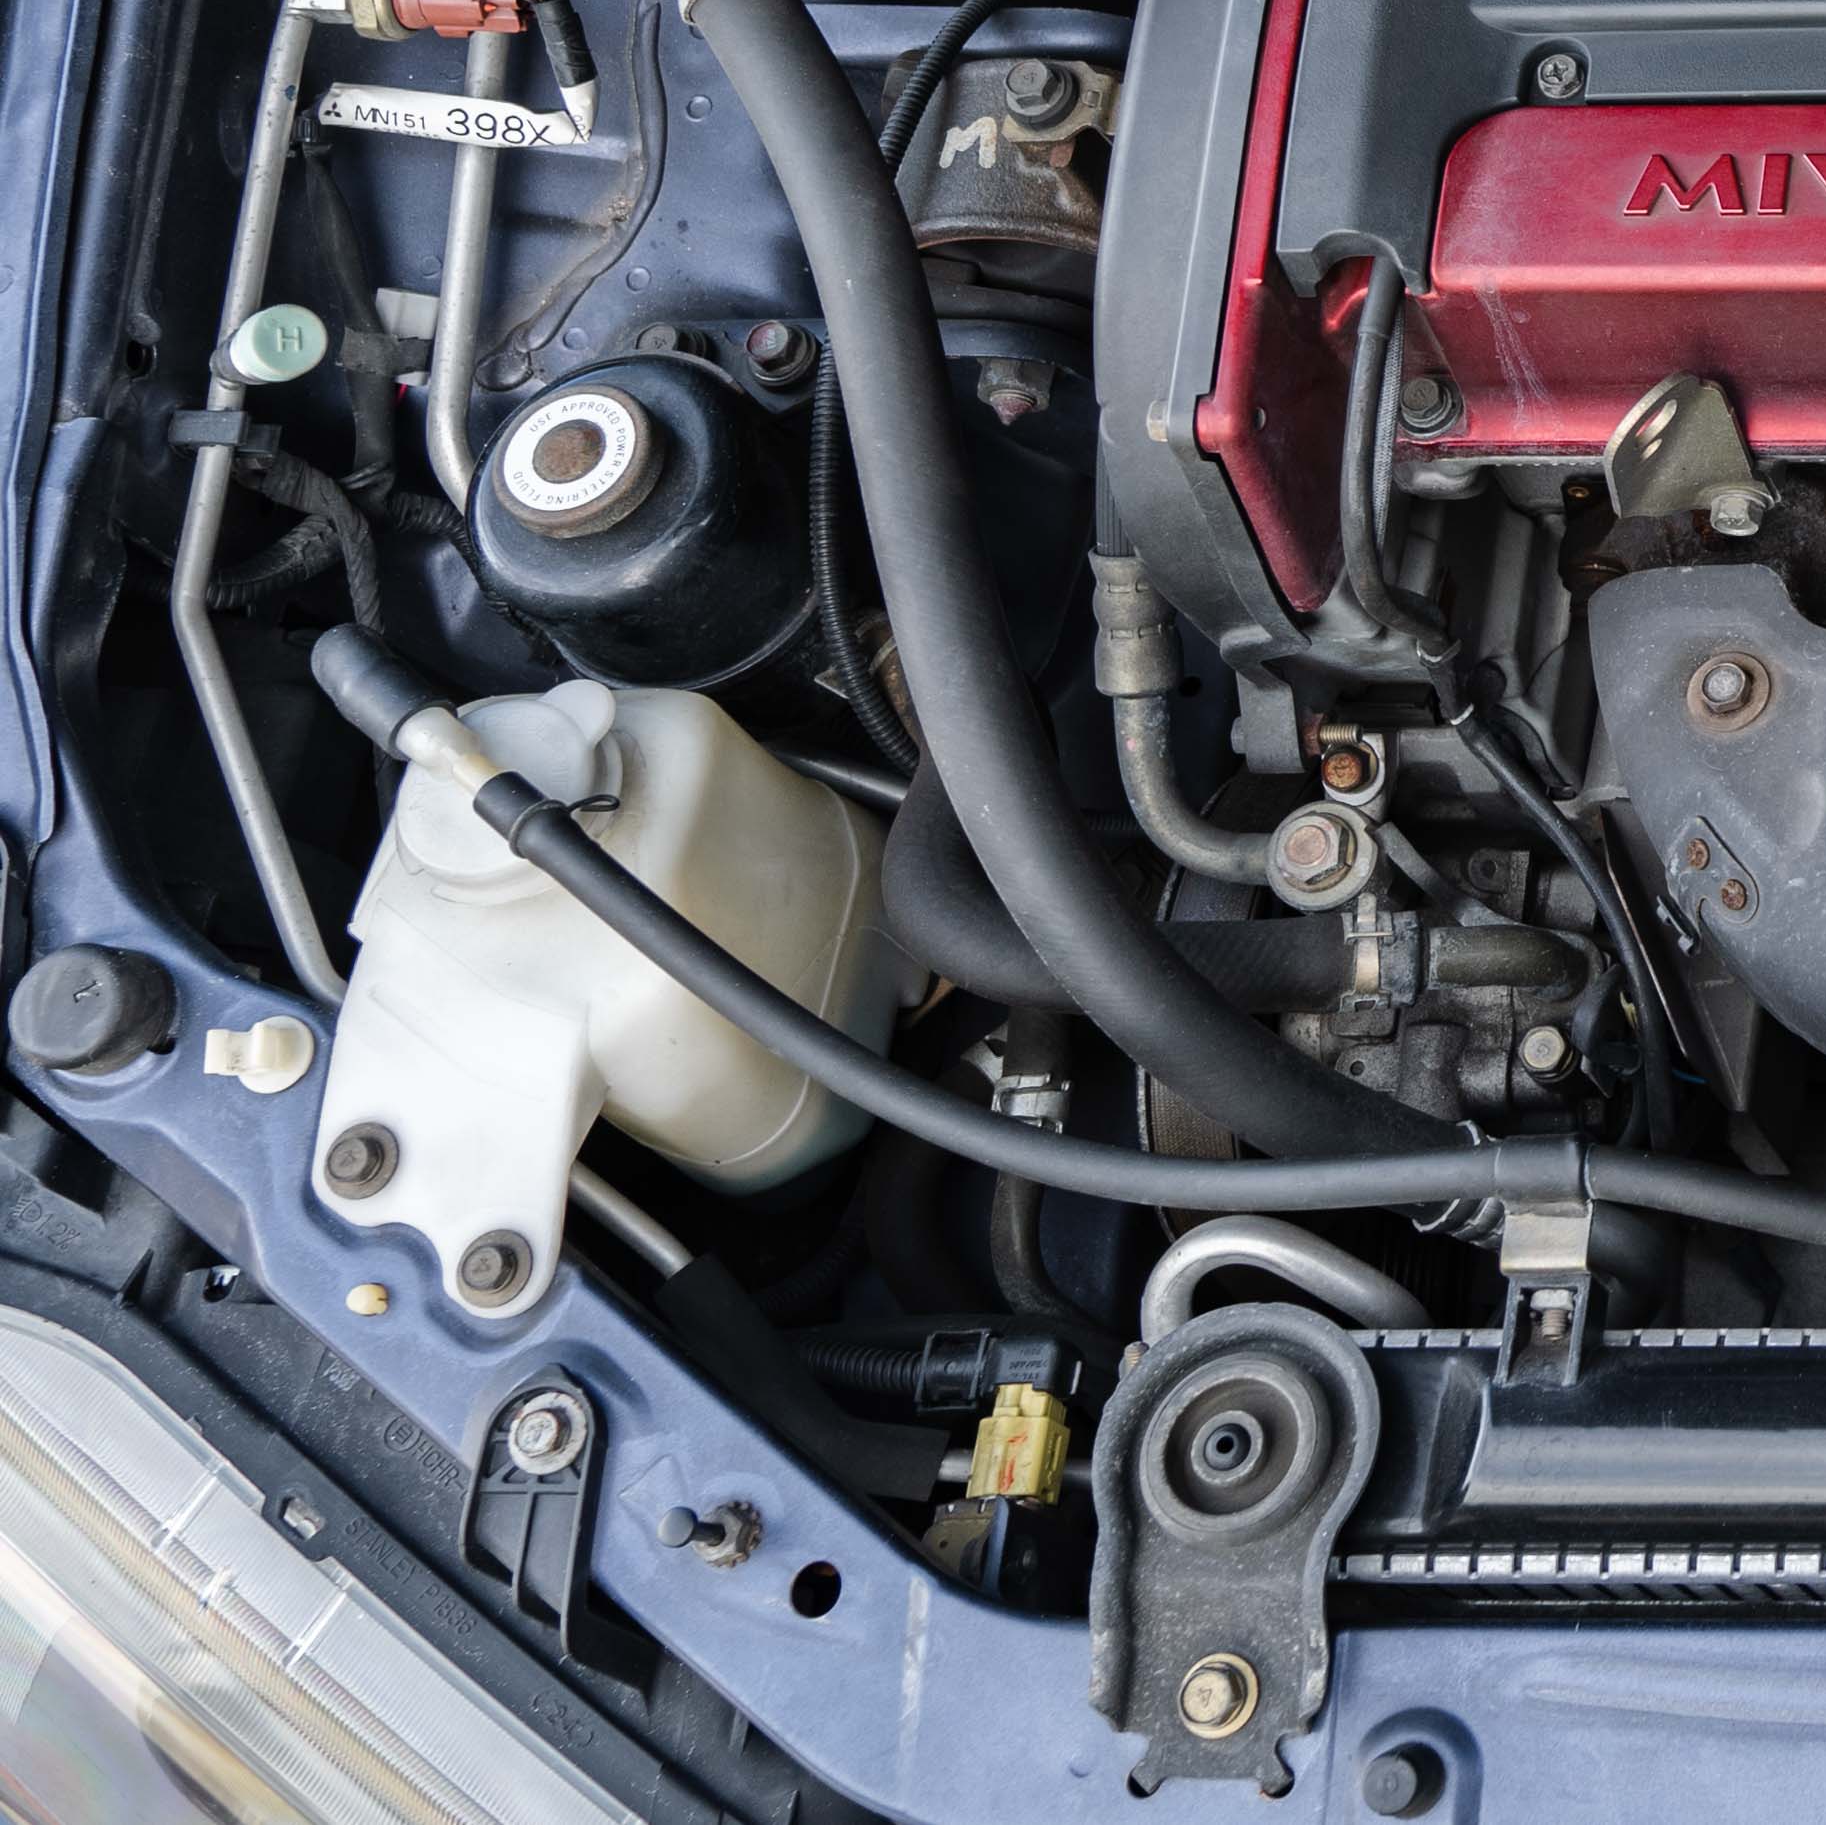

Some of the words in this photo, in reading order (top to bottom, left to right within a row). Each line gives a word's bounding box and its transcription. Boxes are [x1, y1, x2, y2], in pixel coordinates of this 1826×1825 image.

[354, 104, 427, 131] MN151
[445, 107, 556, 147] 398X
[274, 325, 304, 353] H
[529, 411, 553, 434] USE
[561, 400, 621, 425] APPROVED
[612, 427, 627, 469] POWER
[512, 470, 541, 502] FLUID
[545, 470, 615, 505] STEERING
[344, 1515, 419, 1585] STANLEY
